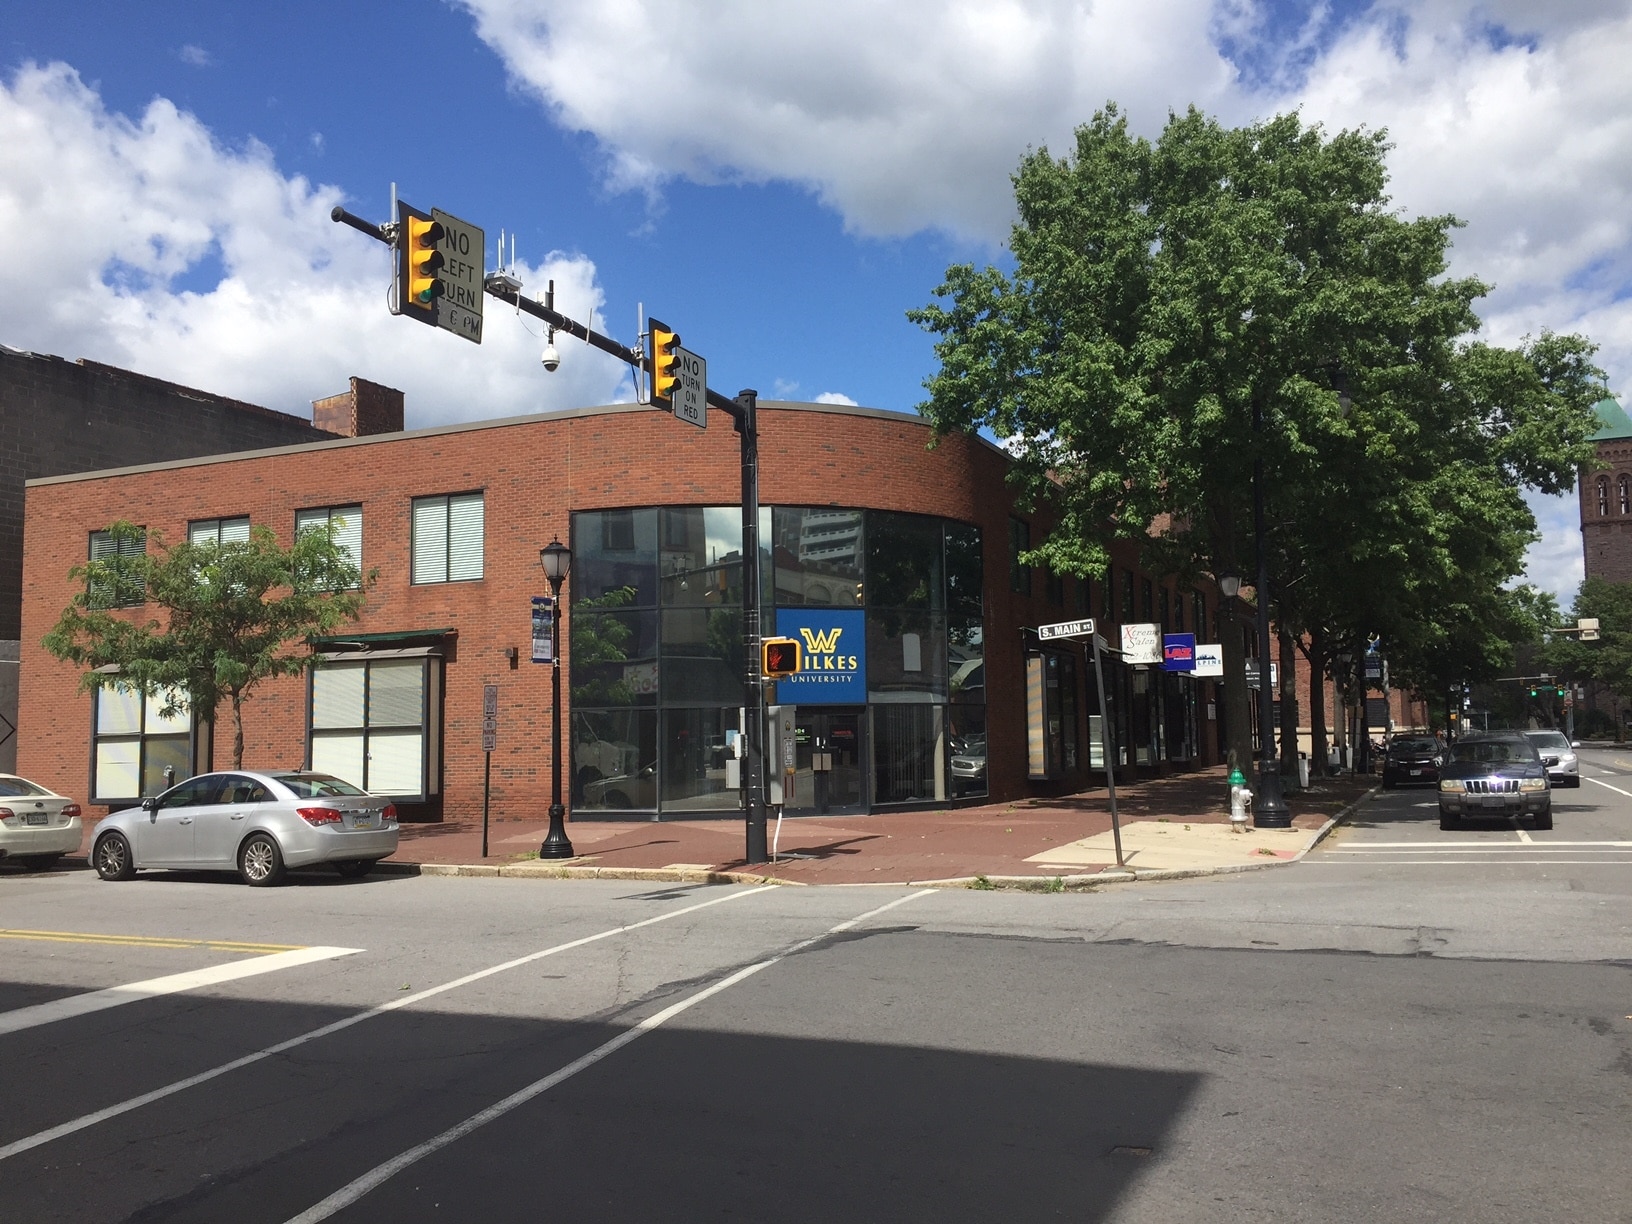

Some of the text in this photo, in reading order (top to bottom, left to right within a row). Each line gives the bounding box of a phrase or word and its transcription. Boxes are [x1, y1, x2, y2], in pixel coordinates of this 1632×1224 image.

[445, 226, 470, 255] NO
[441, 258, 474, 283] LEFT
[463, 316, 480, 336] PM
[683, 355, 699, 375] NO
[682, 374, 700, 392] TURN
[685, 390, 697, 405] ON
[683, 405, 698, 420] RED
[1042, 627, 1052, 637] S.
[1054, 623, 1081, 636] MAIN
[1122, 625, 1160, 640] Xtreme
[1126, 637, 1155, 649] Salon
[804, 655, 858, 670] ILKES
[791, 675, 852, 683] UNIVERSITY
